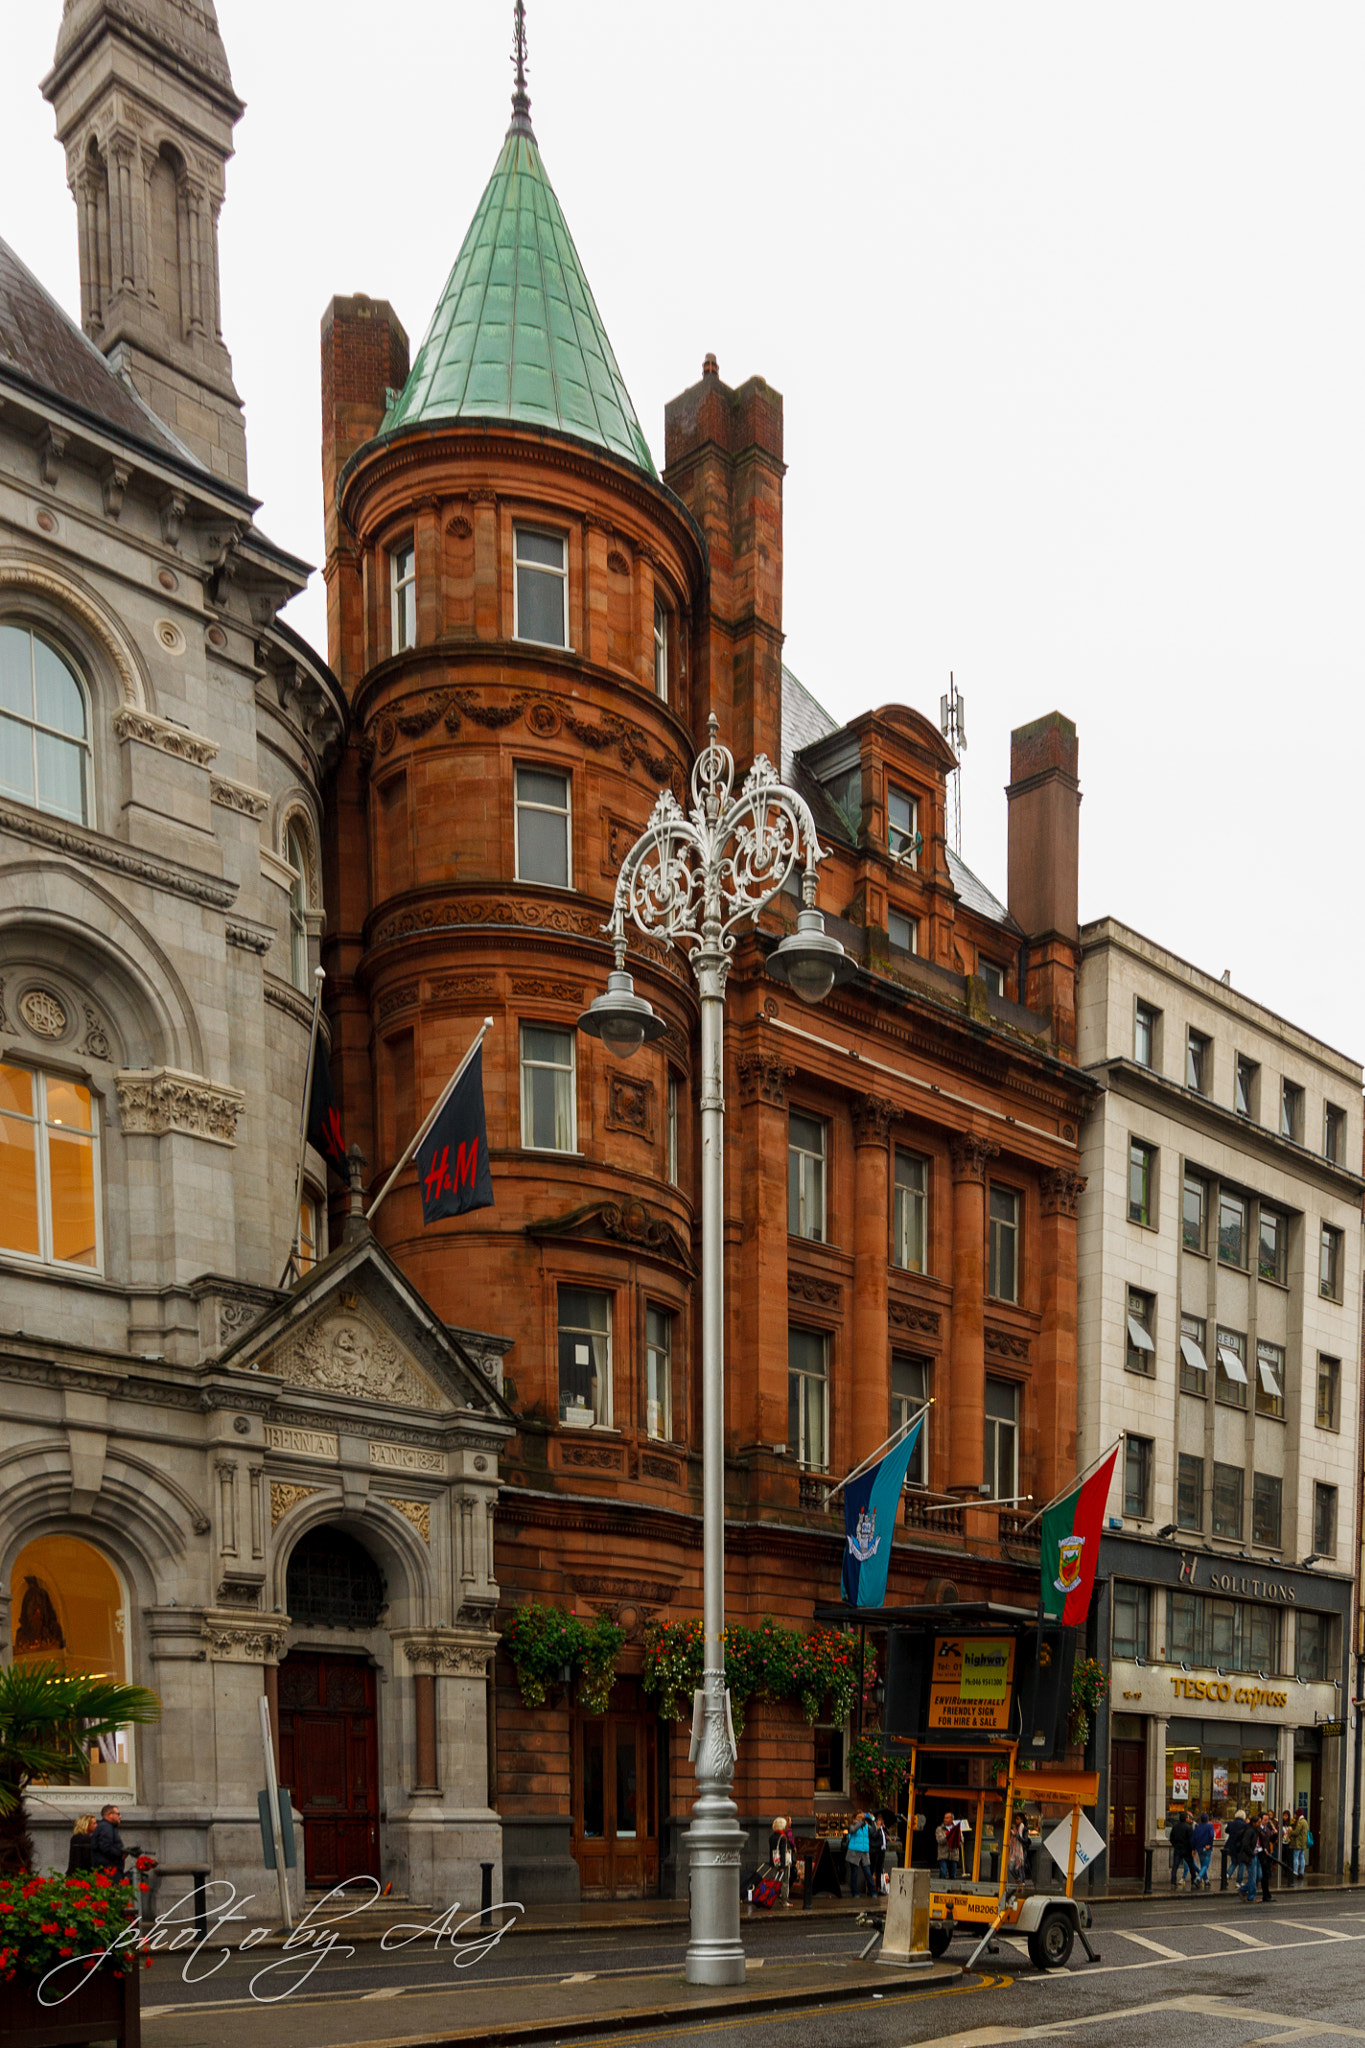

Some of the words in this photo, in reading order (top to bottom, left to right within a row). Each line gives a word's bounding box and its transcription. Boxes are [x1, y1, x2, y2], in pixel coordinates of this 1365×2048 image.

[424, 1136, 479, 1203] H&M
[1211, 1573, 1296, 1602] SOLUTIONS
[964, 1653, 1008, 1668] highway
[1171, 1677, 1232, 1702] TESCO
[1234, 1687, 1288, 1711] express
[938, 1716, 952, 1726] FOR
[953, 1716, 970, 1726] HIRE
[972, 1717, 978, 1727] &
[979, 1717, 997, 1727] SALE
[942, 1706, 977, 1716] FRIENDLY
[977, 1707, 995, 1717] SIGN
